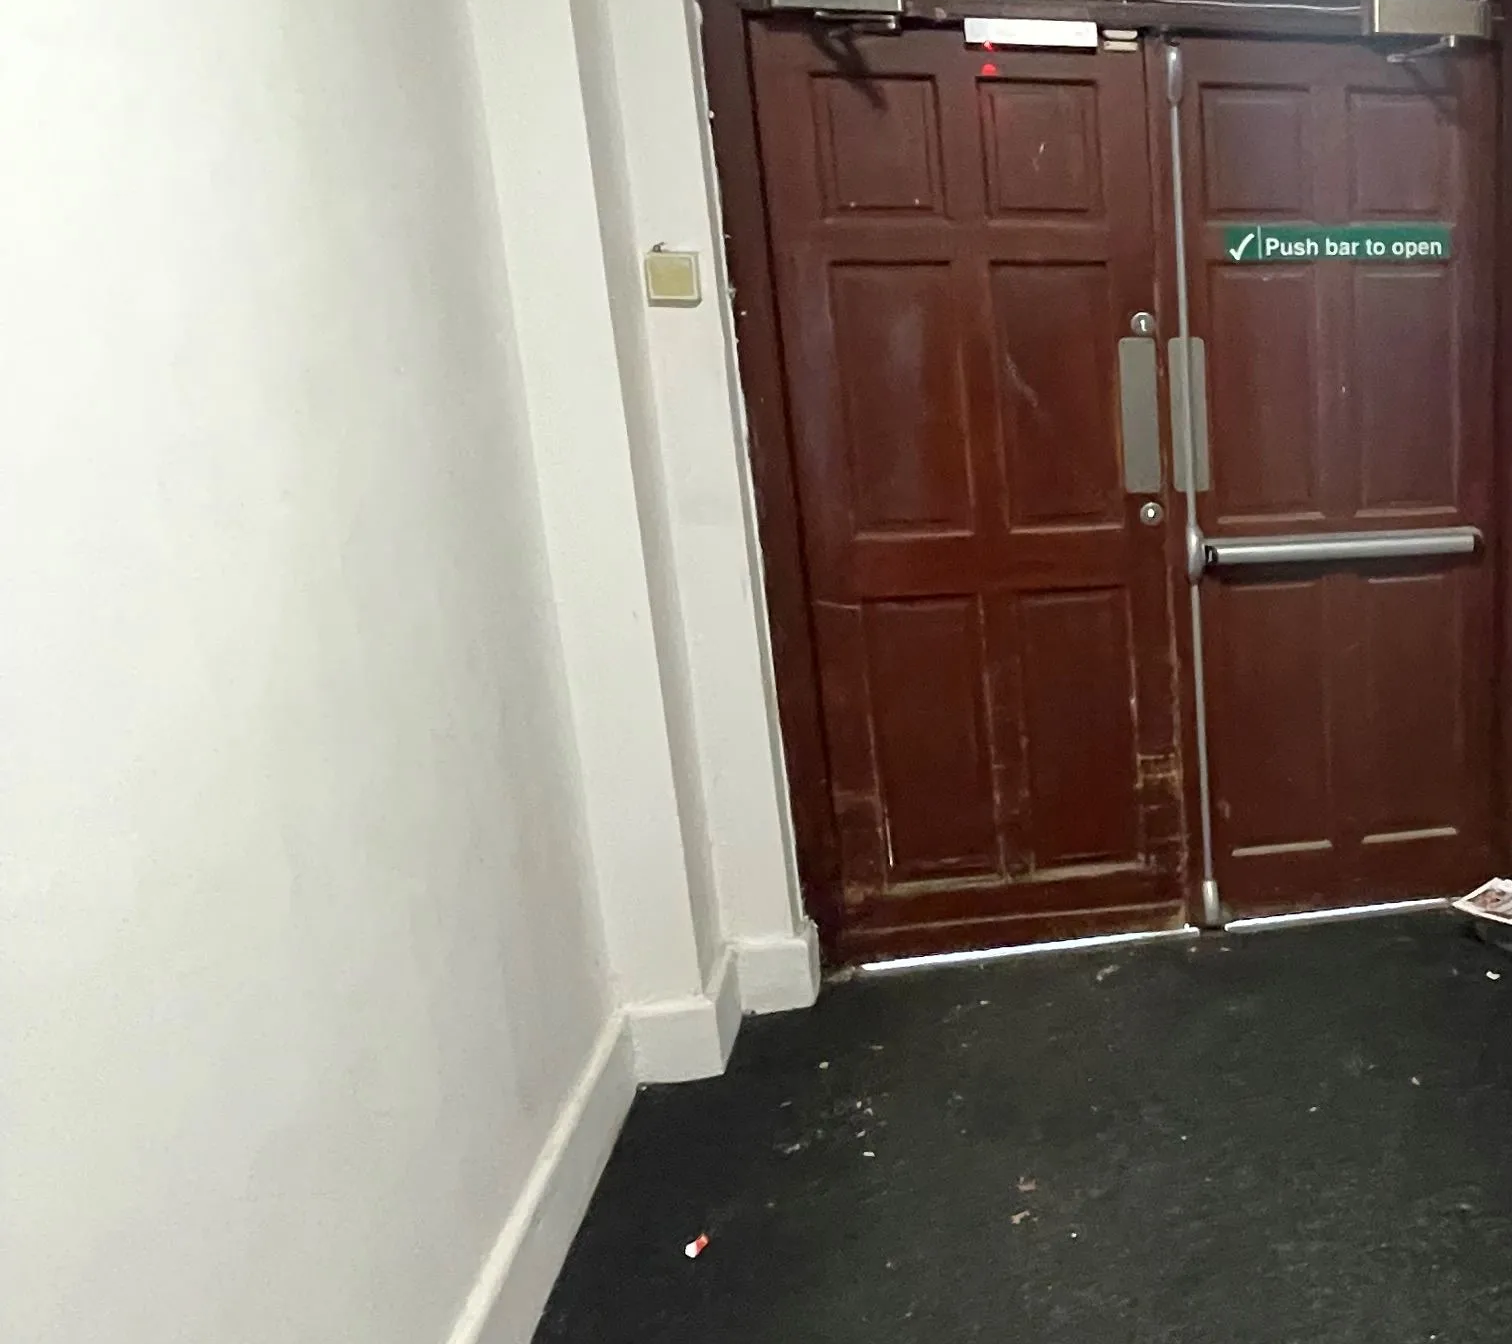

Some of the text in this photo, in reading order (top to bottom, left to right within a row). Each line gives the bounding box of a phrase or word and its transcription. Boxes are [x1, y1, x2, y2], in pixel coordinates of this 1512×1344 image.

[1265, 237, 1442, 259] Push bar to open
